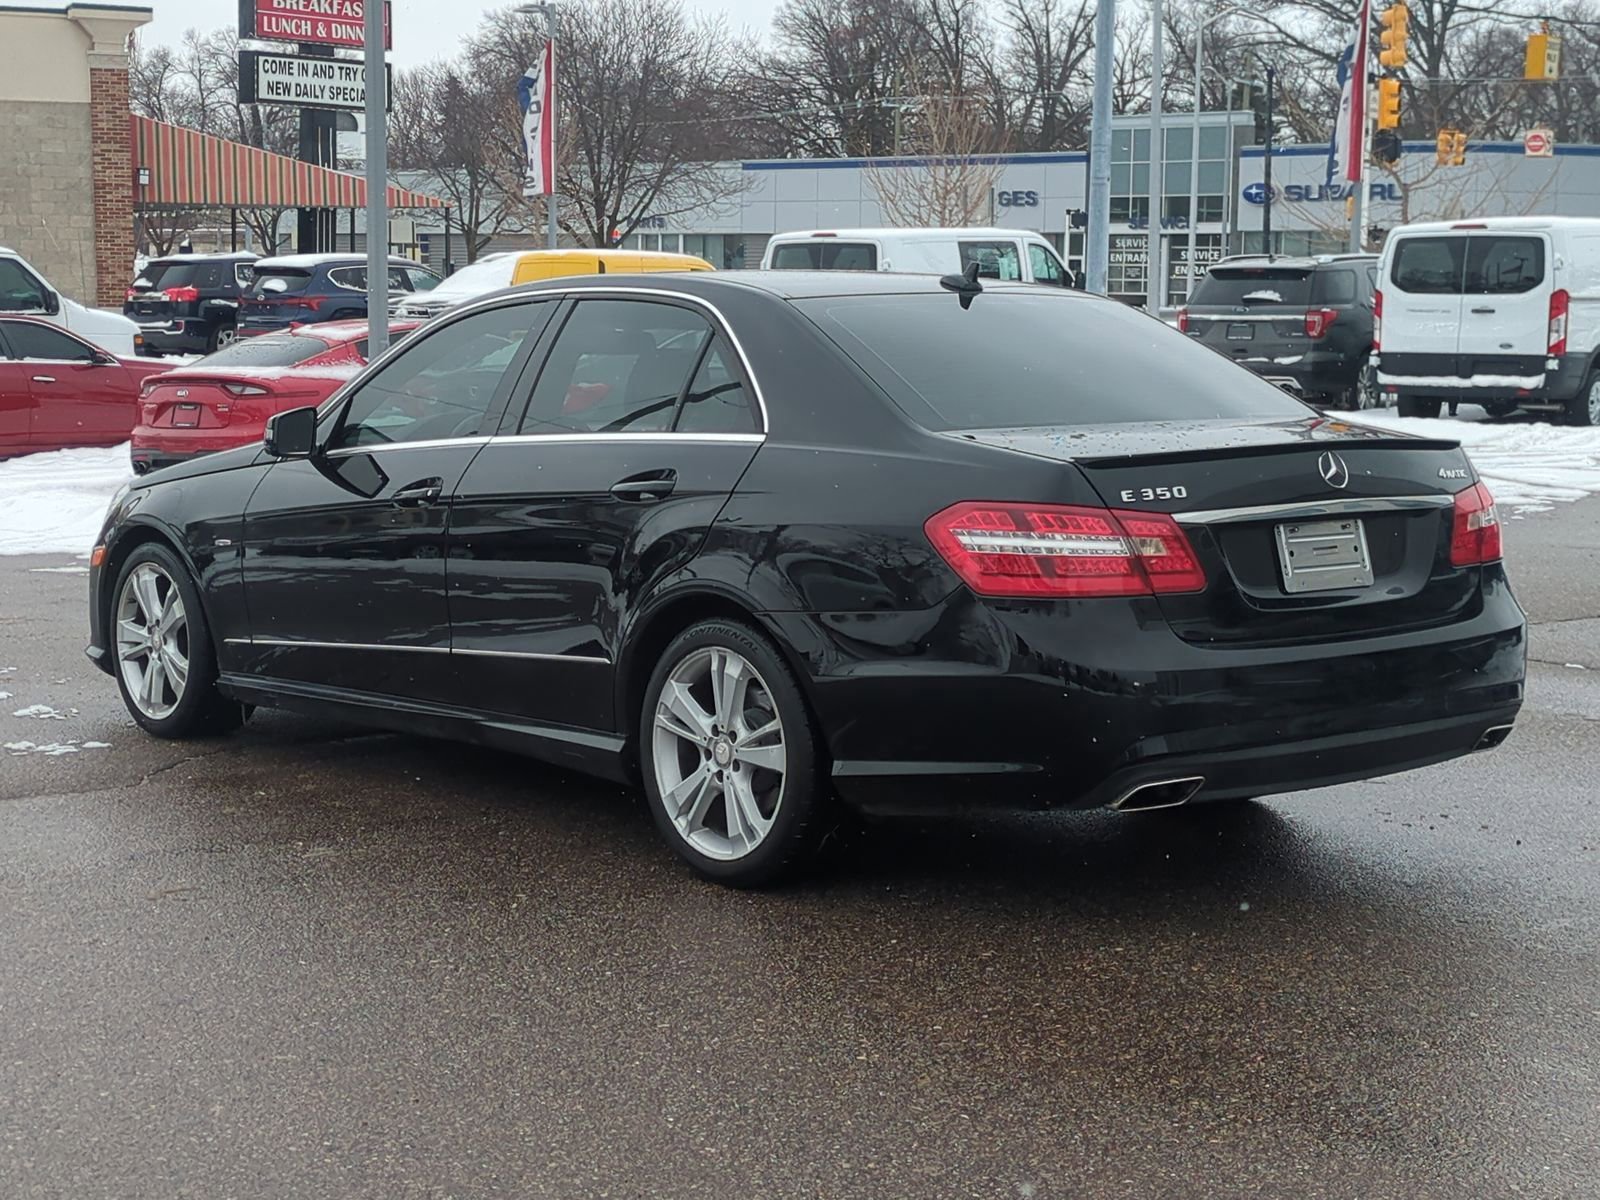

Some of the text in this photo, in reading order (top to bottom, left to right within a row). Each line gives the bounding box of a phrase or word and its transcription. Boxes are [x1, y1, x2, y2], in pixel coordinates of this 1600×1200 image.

[273, 0, 364, 18] BREAKFAS
[263, 16, 365, 41] LUNCH & DINN
[262, 59, 294, 76] COME
[298, 62, 309, 78] IN
[312, 64, 335, 79] AND
[338, 66, 359, 82] TRY
[267, 80, 365, 102] NEW DAILY SPECIA
[627, 217, 665, 229] PRTS
[1128, 216, 1193, 230] SEVIC
[1115, 238, 1149, 248] SERVIC
[1110, 253, 1149, 263] ENTRAN
[1180, 251, 1220, 260] SRVICE
[1121, 486, 1187, 502] E 350
